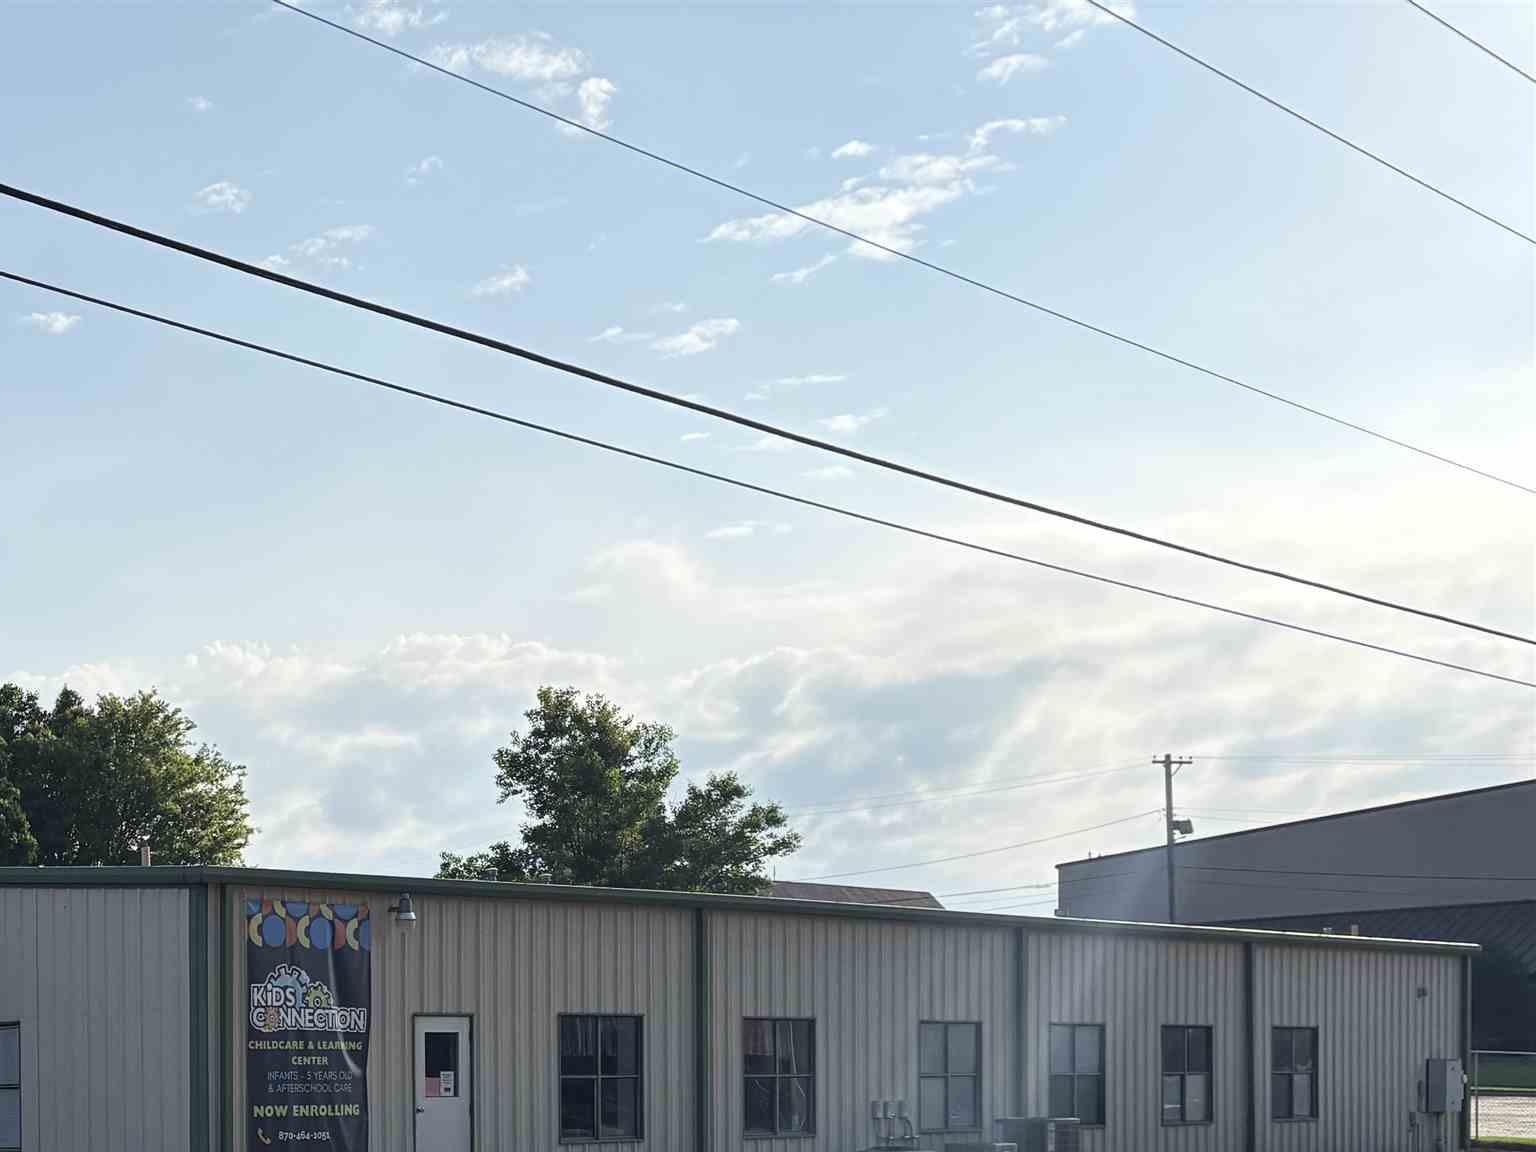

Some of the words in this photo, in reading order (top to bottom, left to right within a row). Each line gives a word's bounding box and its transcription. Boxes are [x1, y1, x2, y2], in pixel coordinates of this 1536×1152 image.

[248, 1040, 305, 1050] CHILDCARE
[307, 1041, 314, 1050] &
[317, 1041, 363, 1050] LEARNING
[291, 1055, 329, 1066] CENTER
[267, 1071, 299, 1081] INFANTS
[314, 1071, 338, 1081] YEARS
[339, 1071, 353, 1081] OLD
[253, 1105, 288, 1118] NOW
[292, 1103, 360, 1117] ENROLLING
